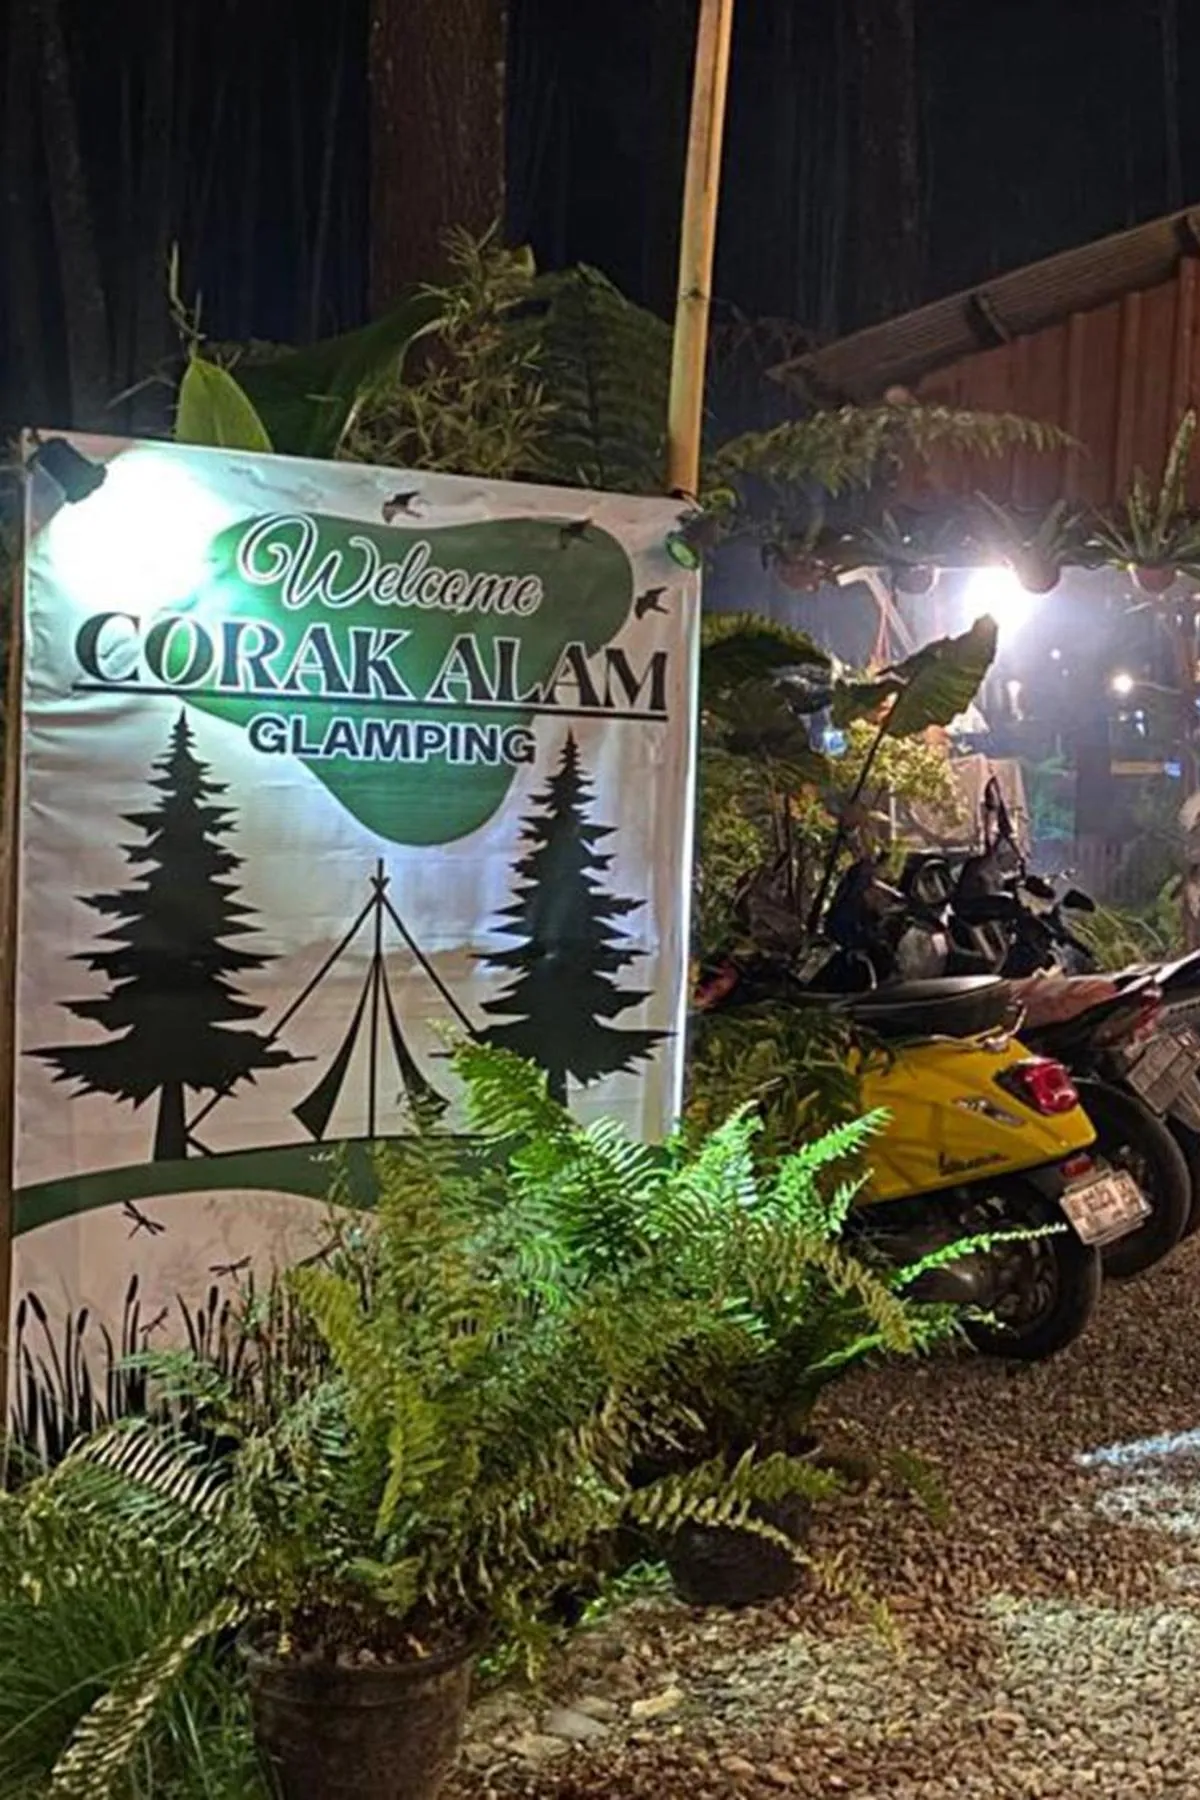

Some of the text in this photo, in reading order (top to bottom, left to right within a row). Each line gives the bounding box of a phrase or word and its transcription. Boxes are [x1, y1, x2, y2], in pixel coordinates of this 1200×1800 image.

[235, 511, 545, 616] Welcome
[73, 610, 668, 711] CORAK ALAM
[247, 713, 537, 766] GLAMPING
